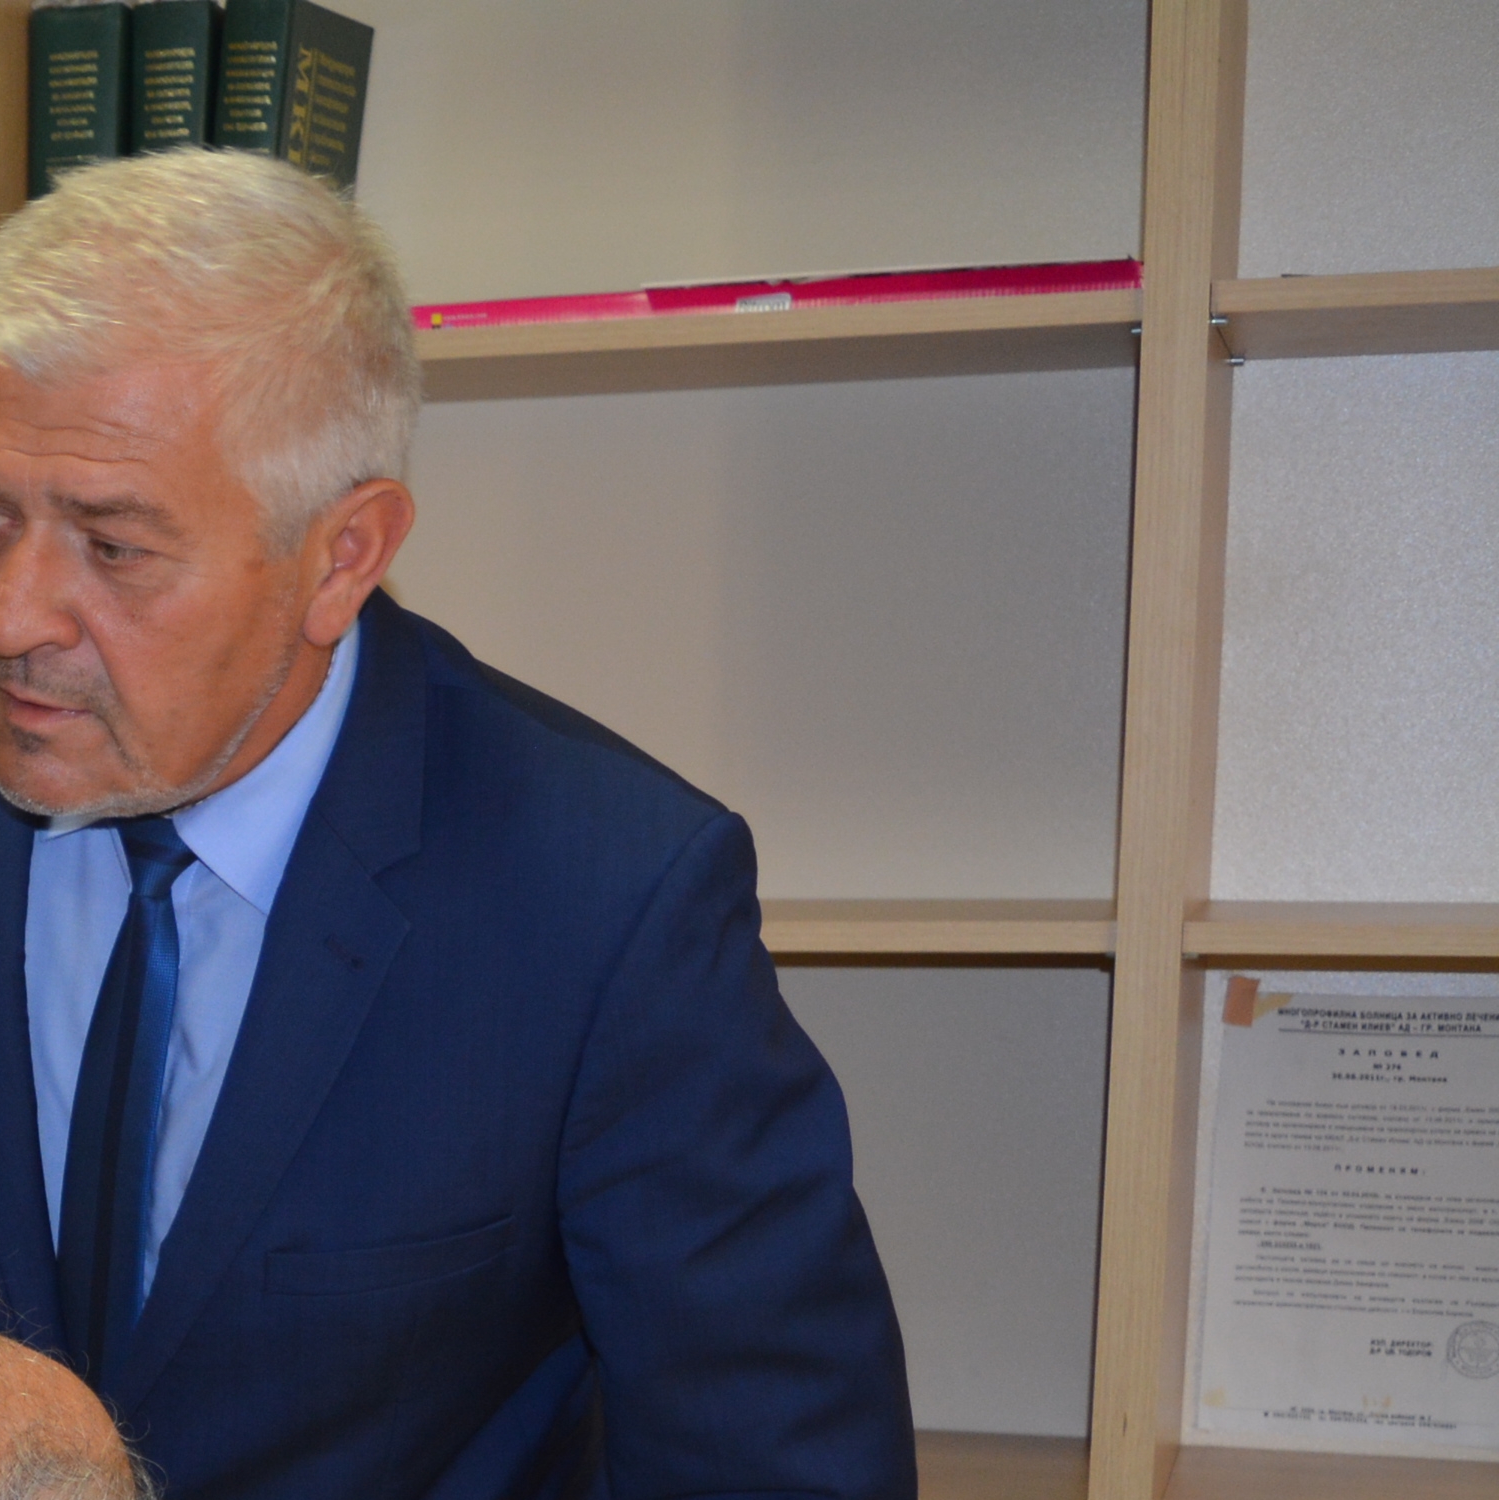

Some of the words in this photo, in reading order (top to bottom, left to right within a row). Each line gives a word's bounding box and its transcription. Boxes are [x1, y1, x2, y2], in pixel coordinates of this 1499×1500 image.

[1278, 1007, 1357, 1018] МНОГОПРОФИЛНА
[1360, 1011, 1402, 1021] БОЛНИЦА
[1406, 1012, 1418, 1020] ЗА
[1420, 1012, 1463, 1021] АКТИВНО
[1322, 1021, 1358, 1029] СТАМЕН
[1398, 1024, 1410, 1032] АД
[1438, 1024, 1481, 1032] МОНТАНА
